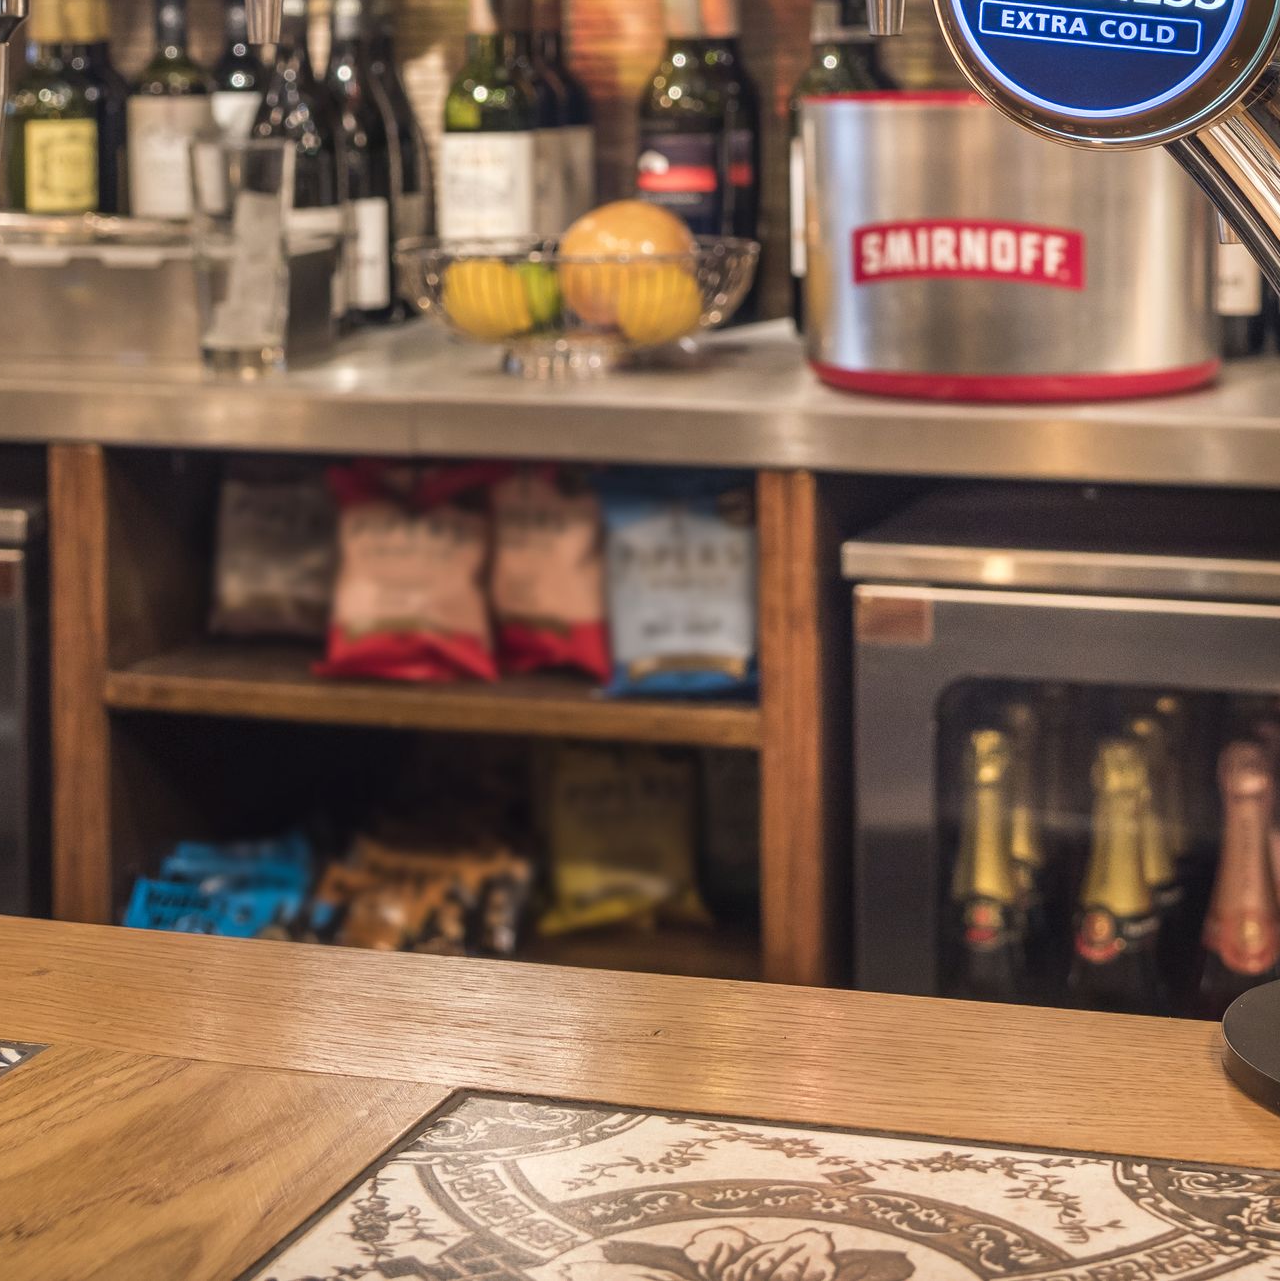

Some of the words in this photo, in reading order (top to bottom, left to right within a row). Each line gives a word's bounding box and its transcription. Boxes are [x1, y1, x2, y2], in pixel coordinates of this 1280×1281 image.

[1000, 9, 1088, 37] EXTRA
[1099, 19, 1176, 45] COLD
[860, 226, 1070, 278] SMIRNOFF
